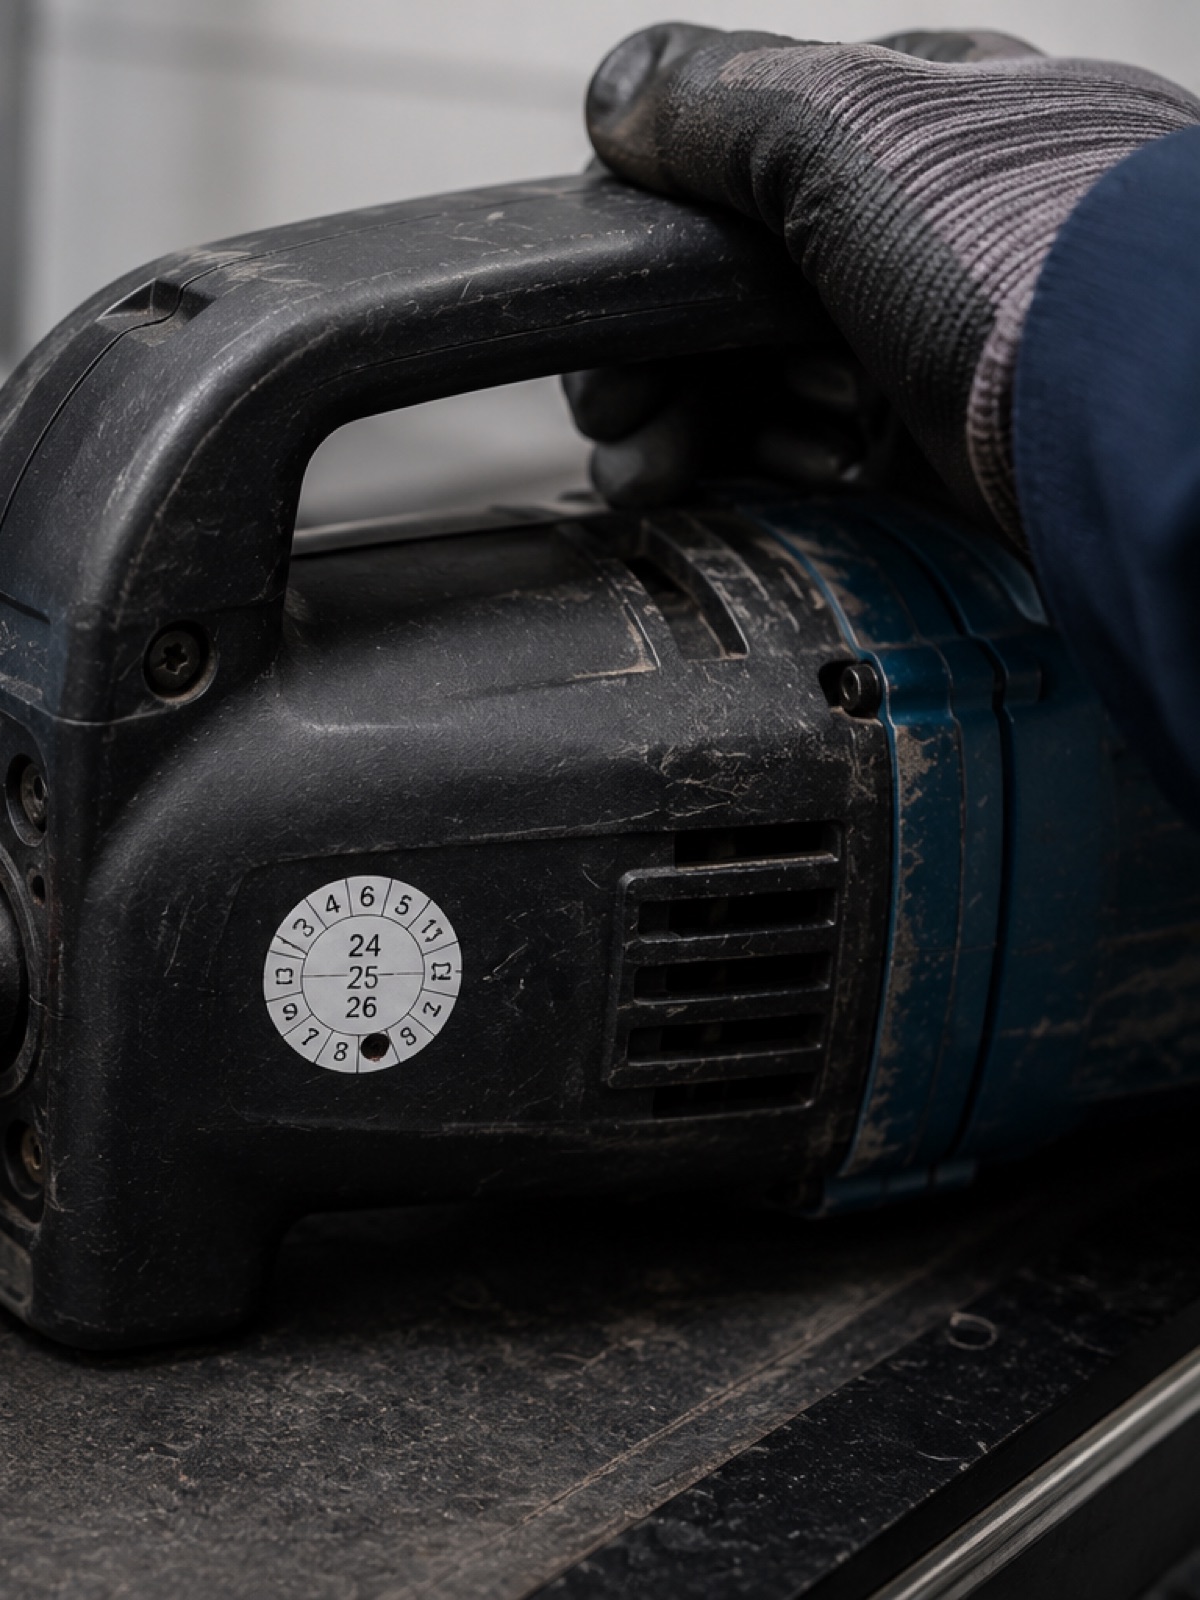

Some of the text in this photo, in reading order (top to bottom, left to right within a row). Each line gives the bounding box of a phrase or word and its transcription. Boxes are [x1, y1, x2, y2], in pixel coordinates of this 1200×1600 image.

[325, 894, 341, 914] 4
[360, 886, 375, 907] 6
[394, 894, 413, 915] 5
[291, 918, 315, 938] 3
[348, 934, 381, 957] 24
[347, 966, 379, 990] 25
[345, 997, 377, 1018] 26
[333, 1041, 349, 1062] 8
